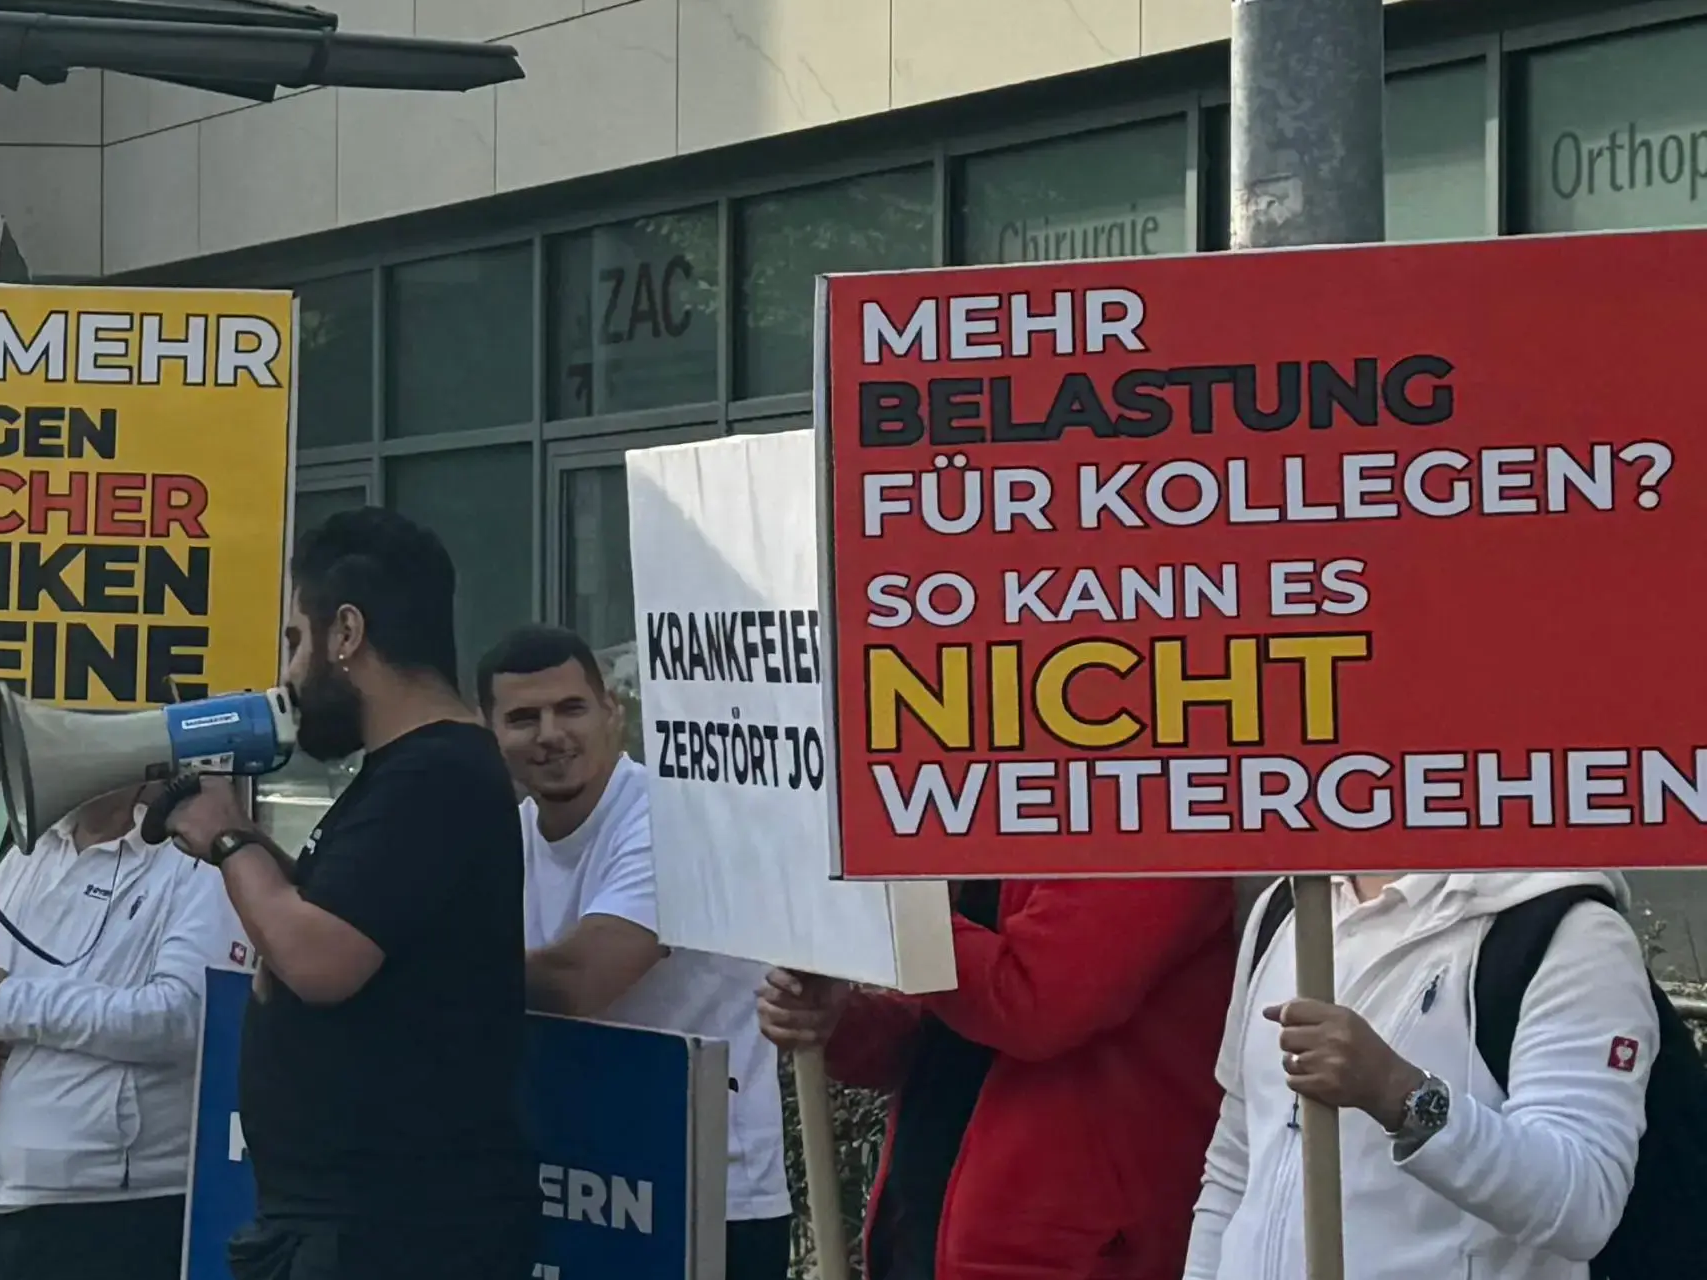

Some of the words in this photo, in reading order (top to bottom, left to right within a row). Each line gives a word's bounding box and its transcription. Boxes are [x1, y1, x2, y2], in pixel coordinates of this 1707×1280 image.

[1552, 122, 1707, 201] Orthop
[598, 255, 694, 345] ZAC
[859, 286, 1152, 367] MEHR
[857, 353, 1455, 449] BELASTUNG
[860, 451, 1058, 539] FÜR
[1075, 438, 1675, 532] KOLLEGEN?
[863, 568, 978, 629] SO
[1002, 560, 1241, 625] KANN
[1268, 557, 1372, 618] ES
[863, 630, 1373, 753] NICHT
[655, 706, 780, 788] ZERSTÖRT
[784, 726, 825, 792] JO
[867, 744, 1707, 838] WEITERGEHEN
